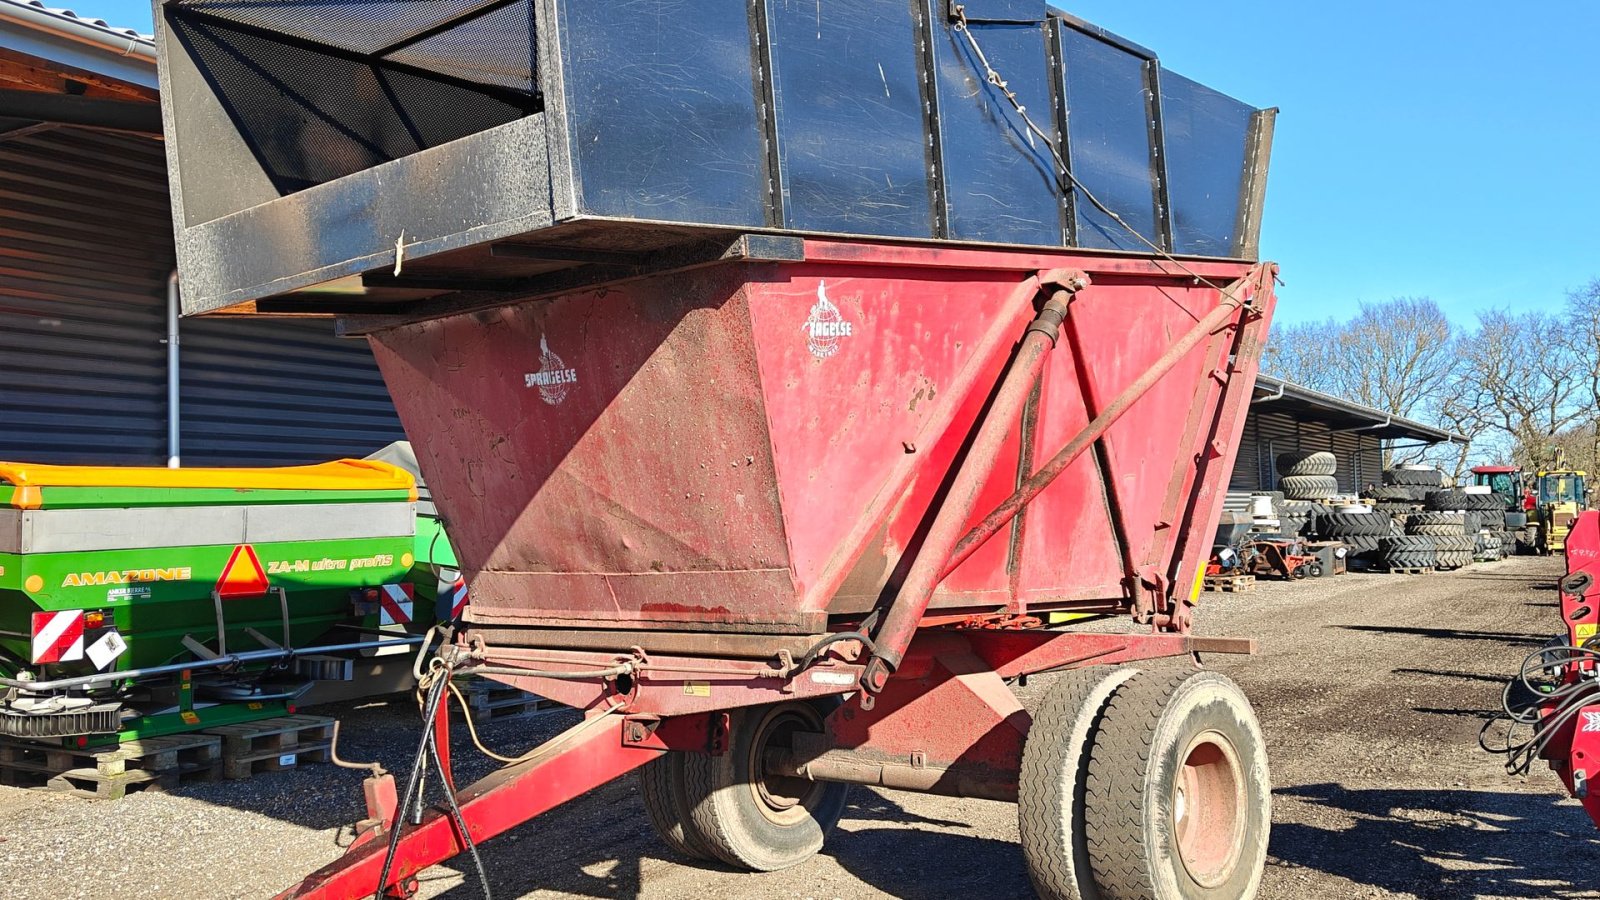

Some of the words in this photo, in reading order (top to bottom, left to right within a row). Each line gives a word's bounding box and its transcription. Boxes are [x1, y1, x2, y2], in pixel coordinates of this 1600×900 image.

[268, 560, 310, 574] ZA-M
[312, 558, 347, 571] ultra
[349, 554, 394, 571] profis
[61, 567, 192, 588] AMAZONE
